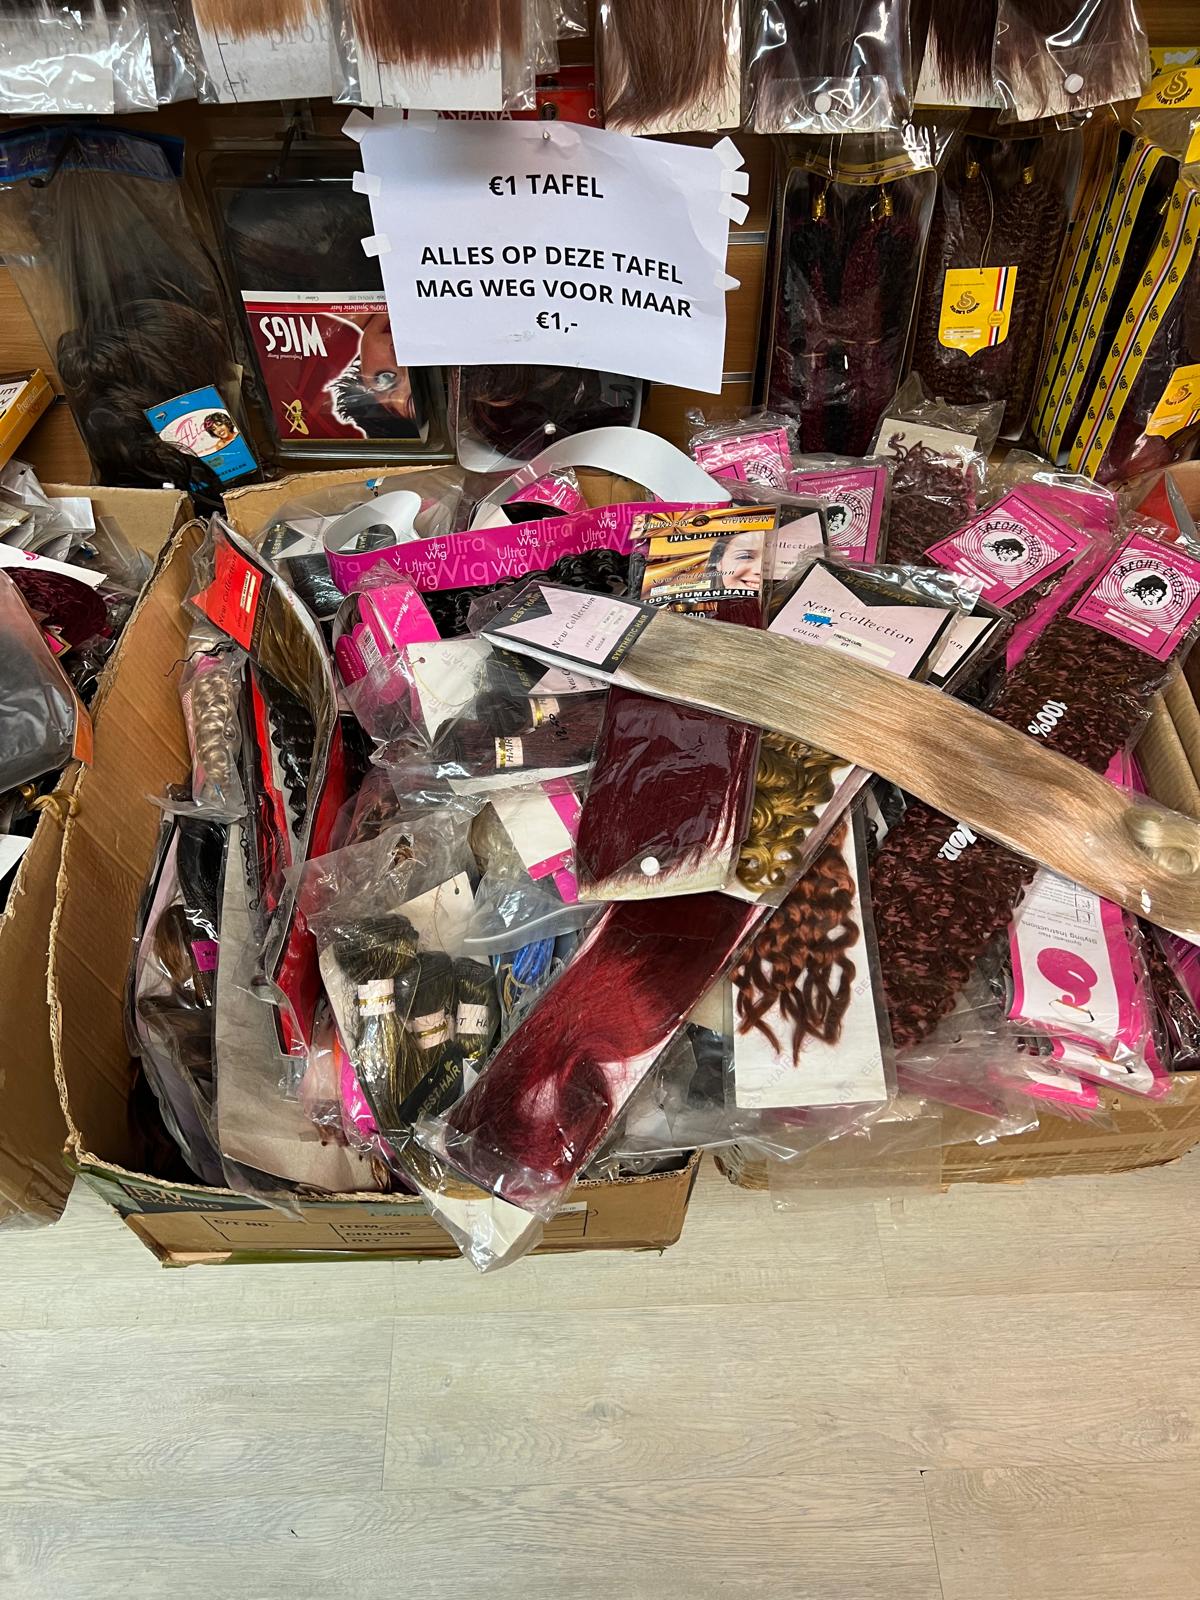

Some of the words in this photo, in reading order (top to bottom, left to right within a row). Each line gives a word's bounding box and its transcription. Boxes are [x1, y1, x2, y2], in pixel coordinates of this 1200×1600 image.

[489, 175, 517, 197] €1
[526, 174, 604, 199] TAFEL
[421, 246, 494, 265] ALLES
[502, 246, 537, 265] OP
[545, 246, 604, 270] DEZE
[612, 252, 684, 285] TAFEL
[416, 279, 473, 298] MAG
[479, 279, 536, 297] WEG
[543, 280, 614, 304] VOOR
[621, 288, 692, 318] MAAR
[536, 311, 578, 334] €1,-
[259, 316, 328, 357] WIGS
[520, 527, 538, 537] Ultra
[598, 518, 617, 530] Wig
[428, 541, 446, 551] Ultra
[516, 534, 538, 547] Wig
[424, 549, 448, 561] Wig
[496, 546, 527, 561] Ultra
[493, 558, 530, 577] Wig
[675, 590, 720, 599] HUMAN
[723, 589, 756, 597] HAIR
[509, 605, 528, 624] BEST
[551, 631, 568, 649] New
[565, 597, 597, 630] Collection
[611, 626, 639, 661] SYNTHETIC
[635, 614, 650, 630] HAIR
[839, 610, 915, 645] Collection
[1027, 700, 1069, 738] 100%
[505, 737, 514, 763] HAIR
[439, 1064, 462, 1092] HAIR
